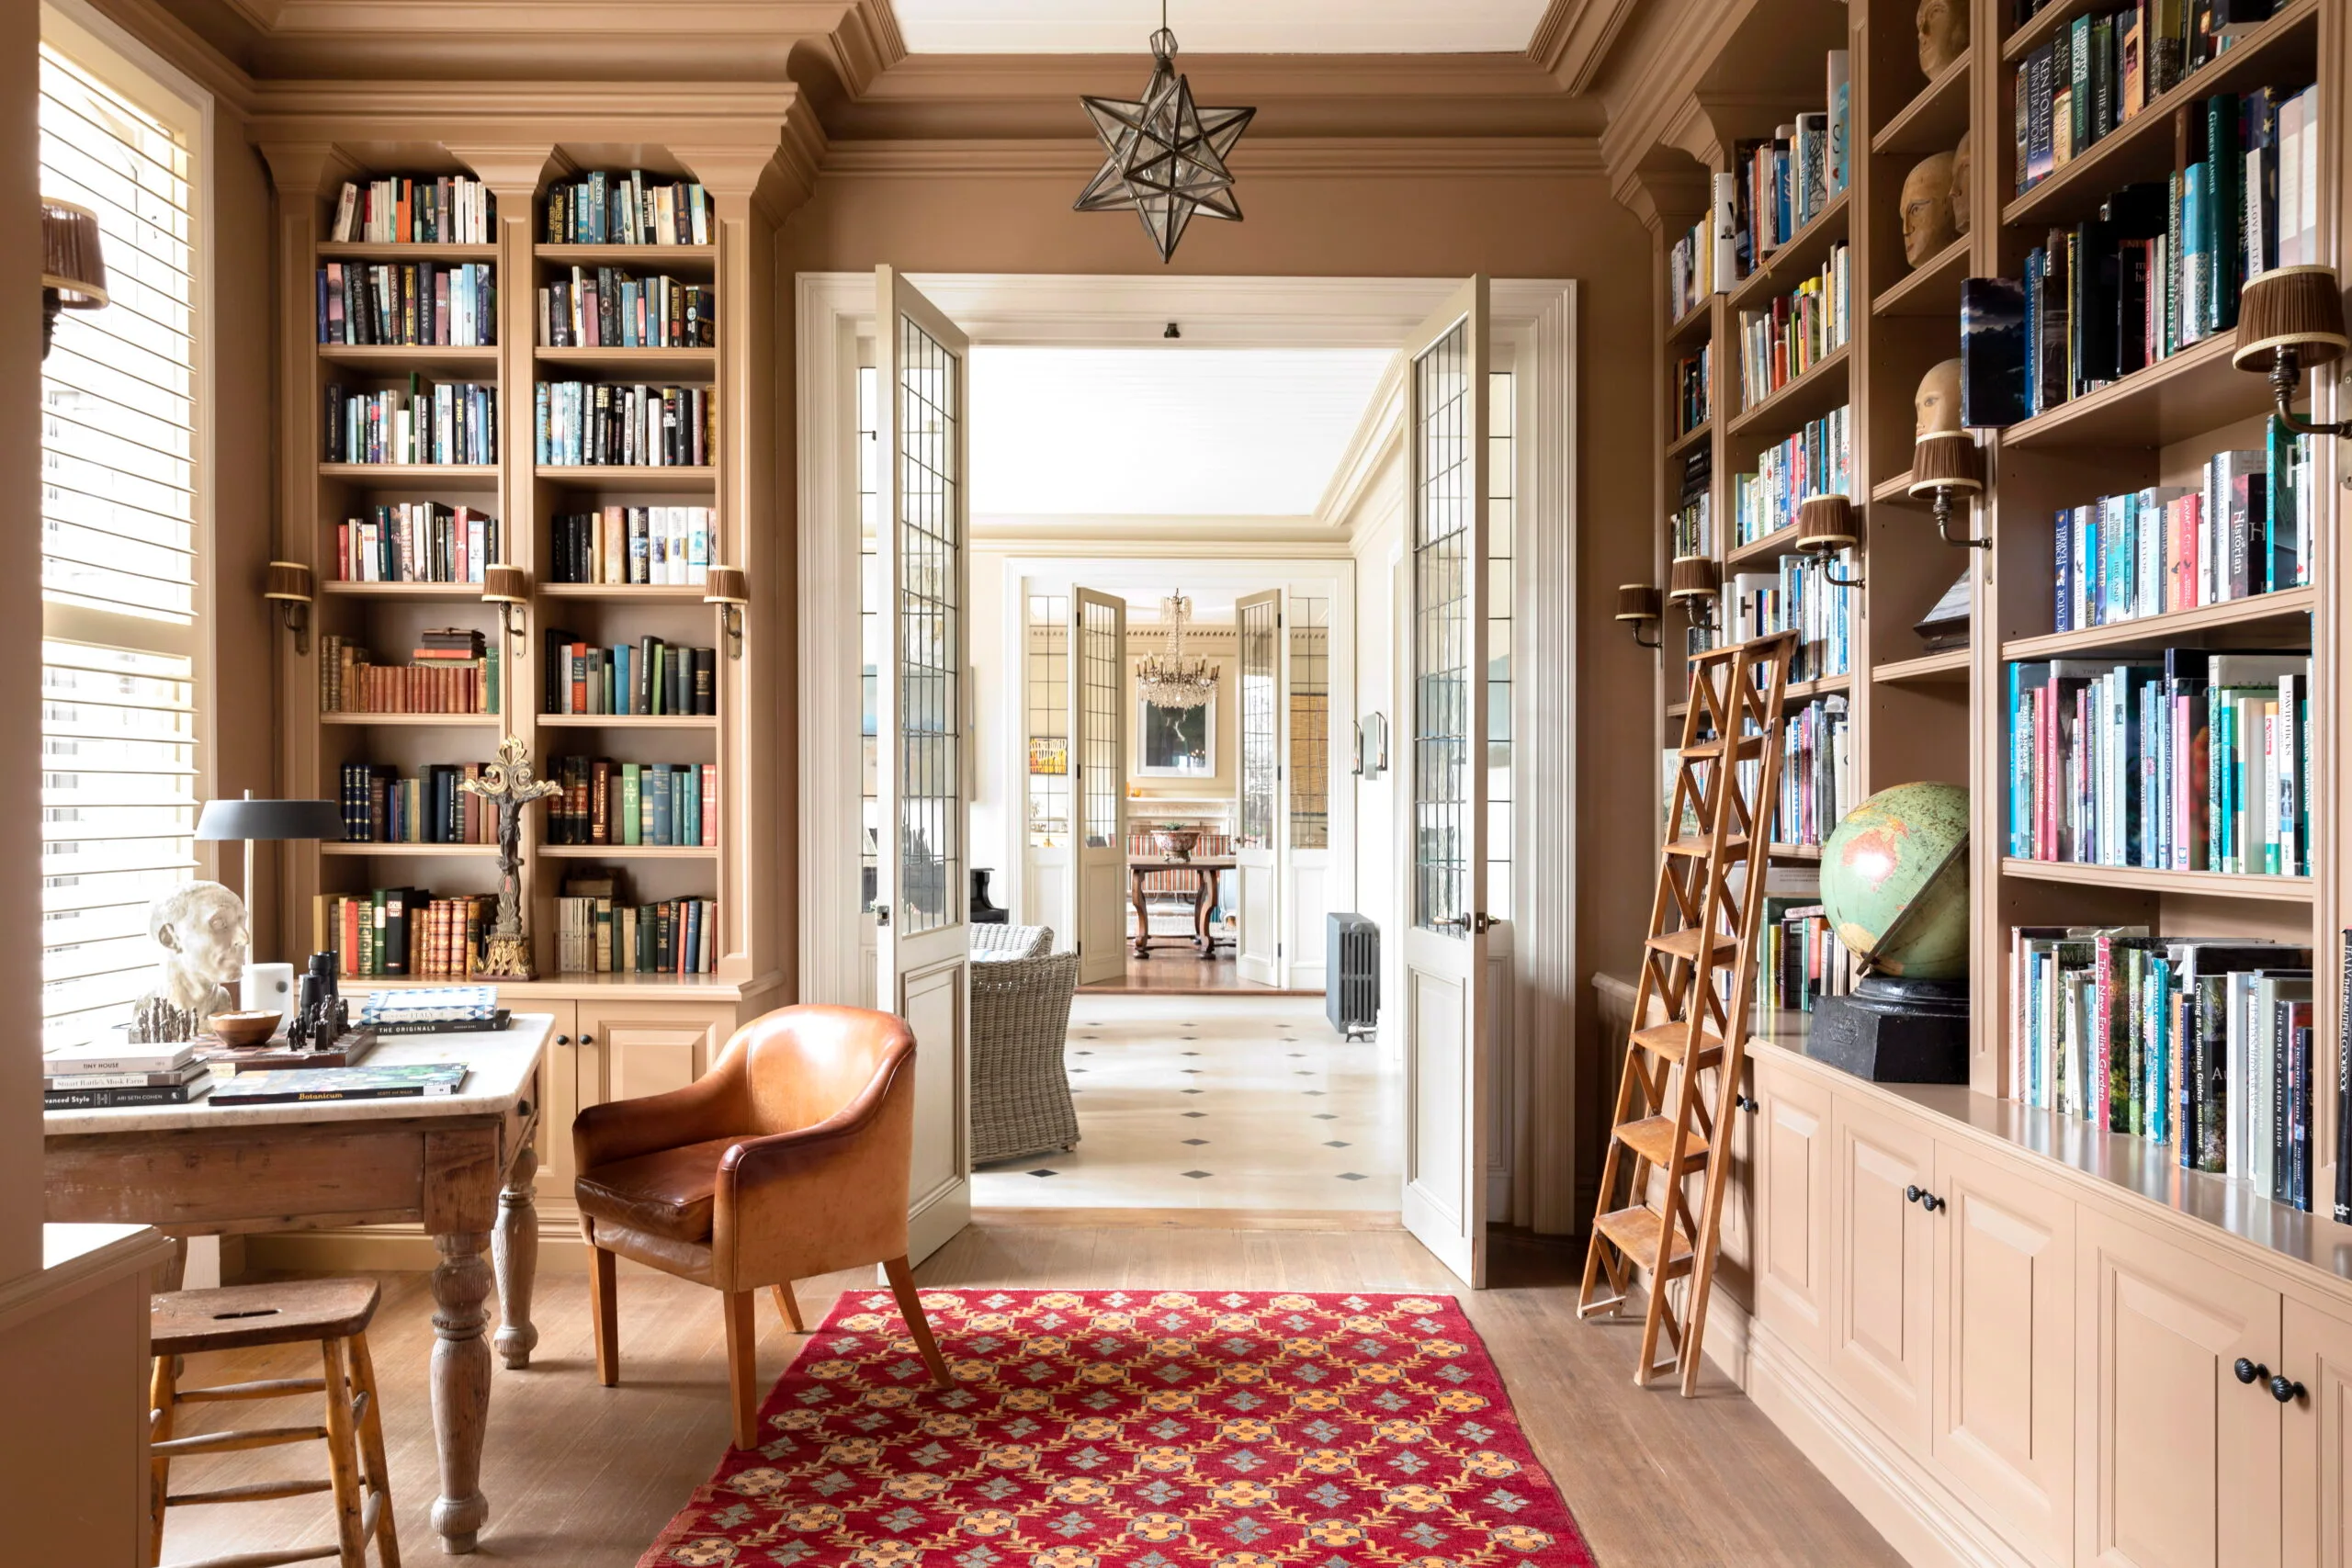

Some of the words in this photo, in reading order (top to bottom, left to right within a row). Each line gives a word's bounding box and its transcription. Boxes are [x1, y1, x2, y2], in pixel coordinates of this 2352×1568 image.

[2040, 56, 2052, 90] KEN
[2053, 38, 2062, 87] FOLLETT
[2061, 43, 2069, 72] KEN
[2079, 25, 2087, 81] CHRISTOS
[2030, 61, 2040, 108] WINTER
[2098, 85, 2107, 111] THE
[2040, 90, 2052, 153] FOLLETT
[2076, 83, 2085, 140] barracuda
[2098, 110, 2107, 137] SLAP
[2209, 110, 2218, 152] GARDEN
[2030, 117, 2040, 160] WORLD
[2098, 499, 2107, 542] JEFFREY
[2233, 509, 2245, 575] Historian
[2098, 543, 2107, 589] ARCHER
[2098, 958, 2108, 976] The
[2342, 978, 2350, 994] THE
[2098, 985, 2108, 1012] New
[2194, 982, 2203, 1016] Creating
[2340, 994, 2350, 1038] BEAUTIFUL
[2098, 1016, 2108, 1056] English
[2195, 1017, 2203, 1028] an
[2196, 1029, 2204, 1071] Australian
[2276, 1063, 2283, 1075] OF
[2339, 1039, 2348, 1092] COOKBOOK
[57, 1079, 78, 1089] Stuart
[298, 1091, 344, 1101] Botanicum
[2098, 1058, 2108, 1101] Garden
[2196, 1072, 2205, 1101] Garden
[44, 1096, 70, 1105] vanced
[71, 1095, 90, 1104] Style
